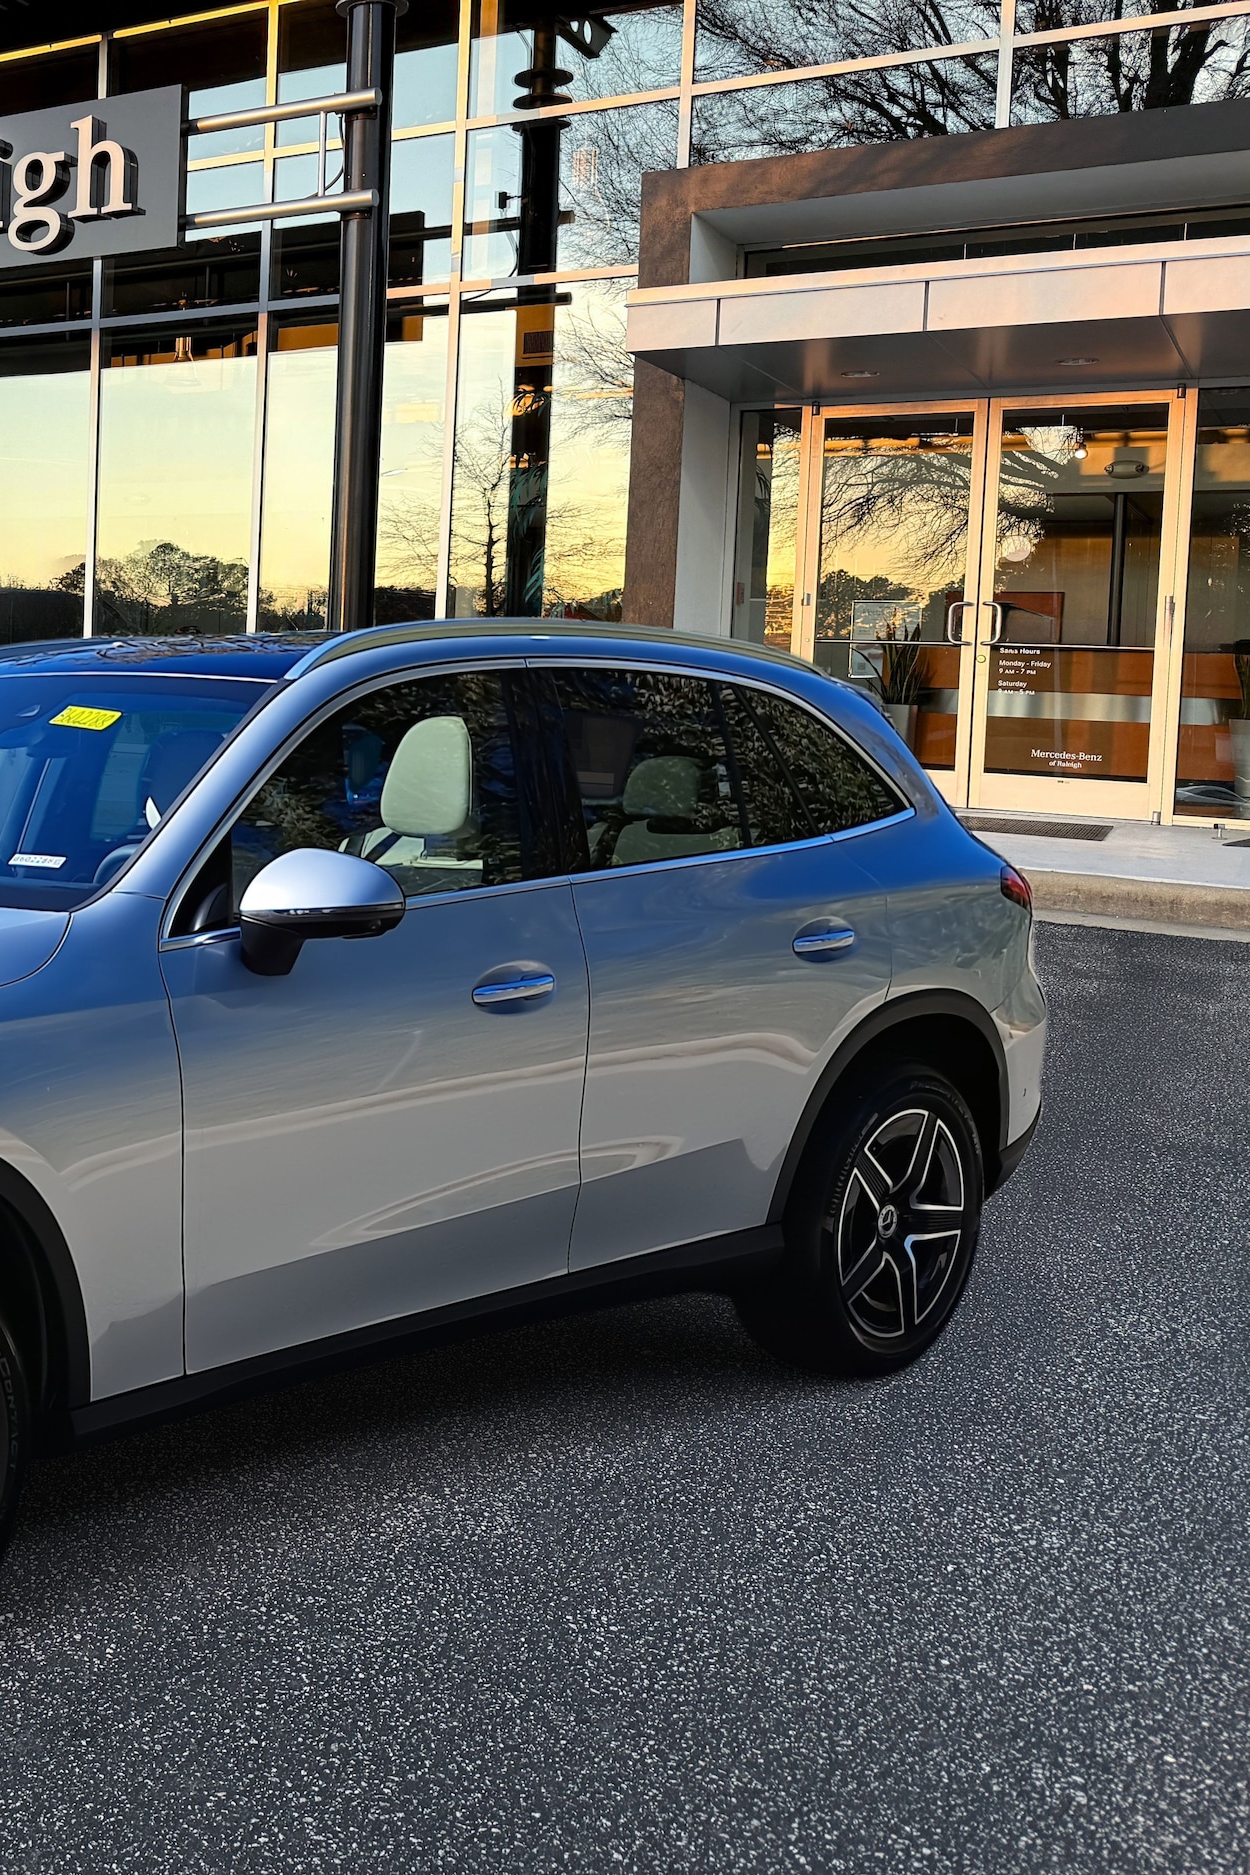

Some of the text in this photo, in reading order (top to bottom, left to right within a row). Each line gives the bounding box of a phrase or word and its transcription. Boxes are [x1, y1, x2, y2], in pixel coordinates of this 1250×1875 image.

[998, 660, 1025, 668] Monday
[1030, 660, 1051, 668] Friday
[998, 680, 1027, 688] Saturday
[1031, 749, 1103, 762] Mercedes-Benz
[1056, 760, 1083, 769] Raleigh
